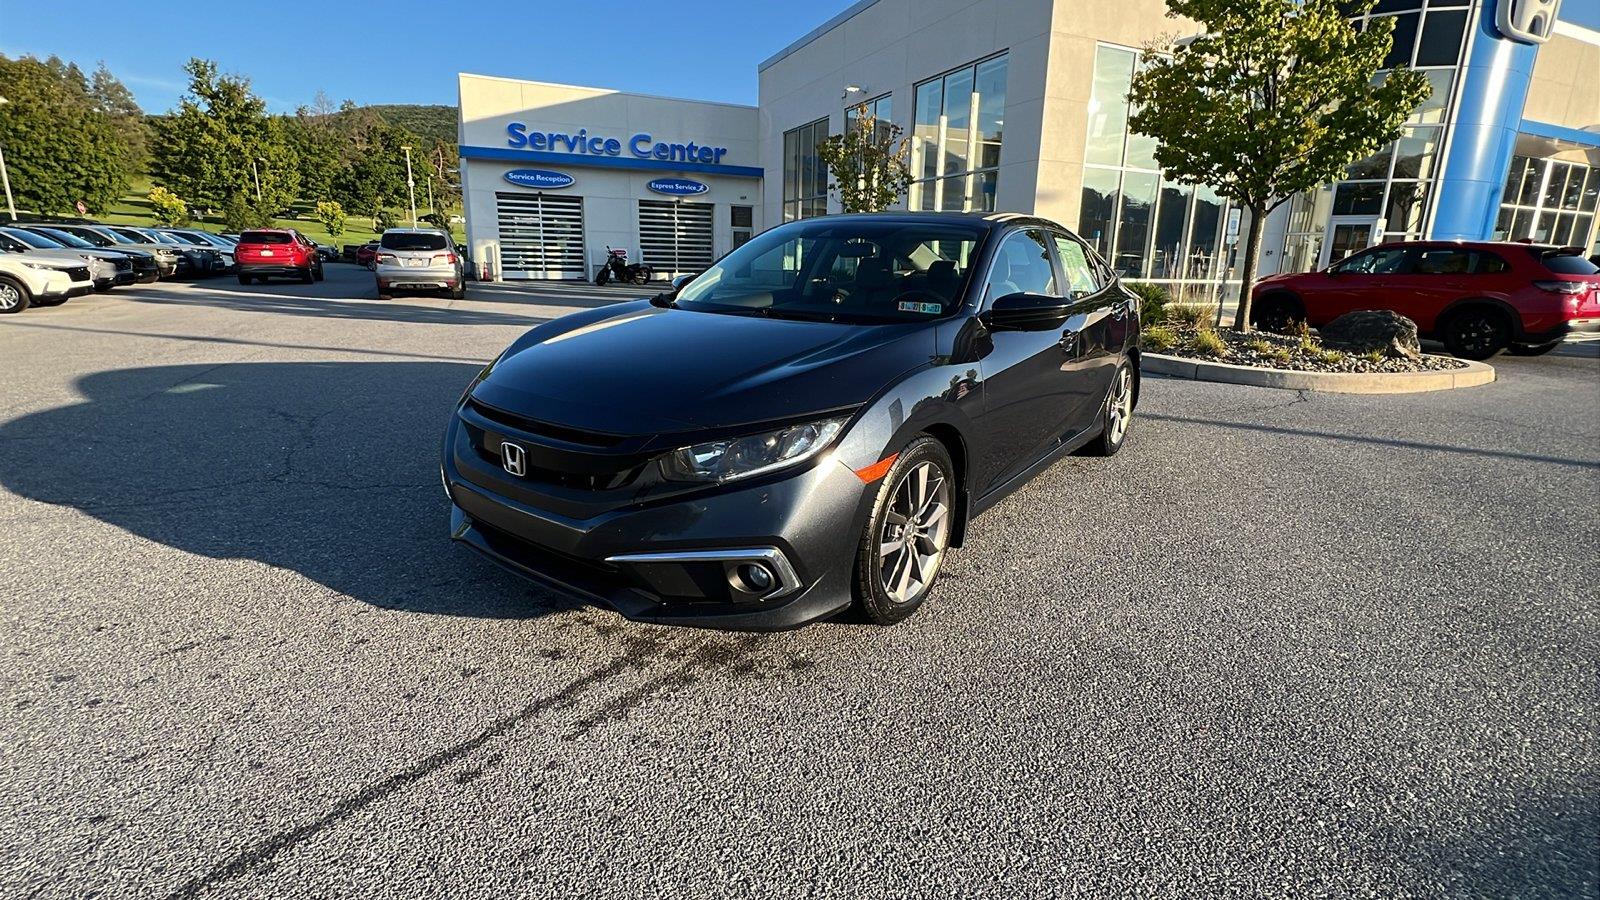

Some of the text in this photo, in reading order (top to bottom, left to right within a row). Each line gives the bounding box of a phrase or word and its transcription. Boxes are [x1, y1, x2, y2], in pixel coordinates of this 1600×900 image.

[506, 122, 728, 164] Service Center
[508, 172, 571, 184] Service Reception
[651, 182, 697, 191] Express Service
